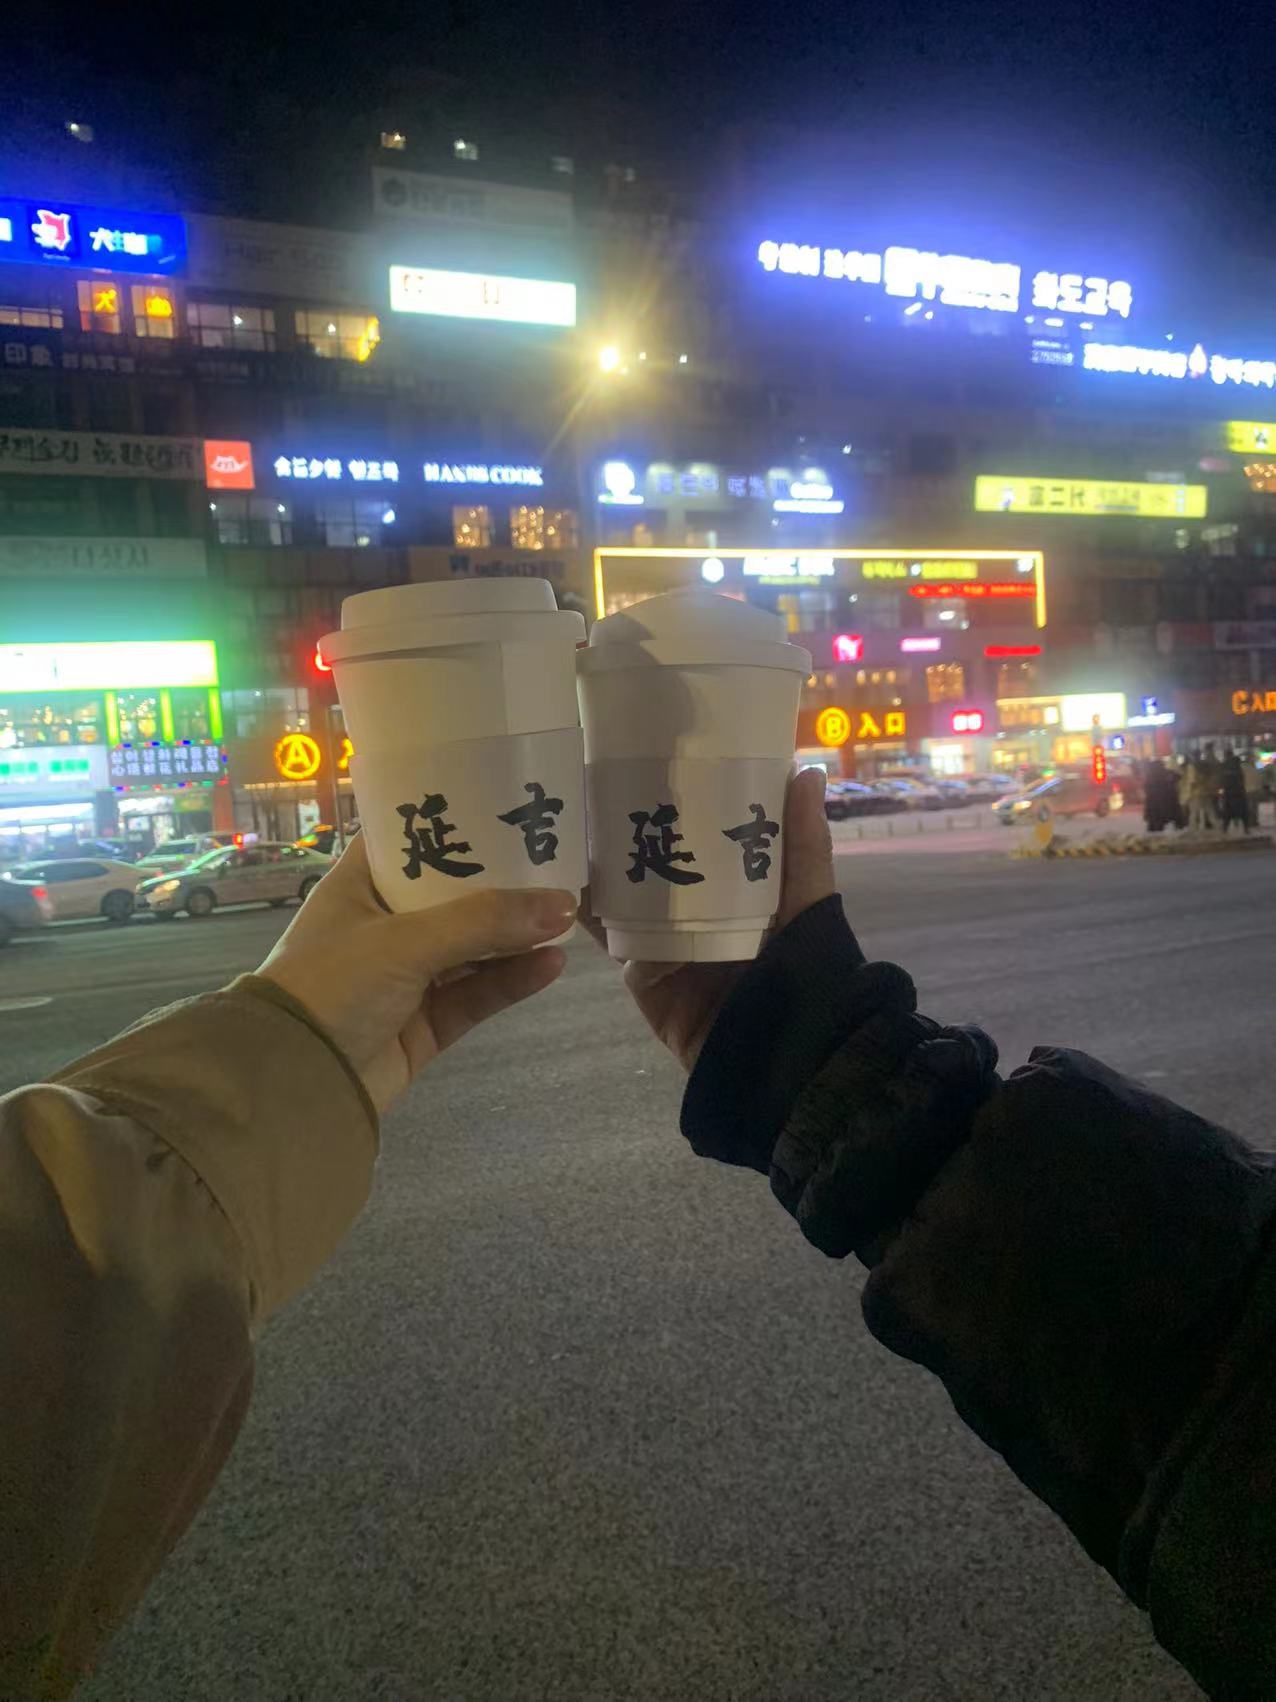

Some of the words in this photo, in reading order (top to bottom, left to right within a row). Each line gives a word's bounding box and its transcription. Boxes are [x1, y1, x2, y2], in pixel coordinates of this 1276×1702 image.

[857, 711, 905, 738] 入口
[396, 782, 564, 880] 延吉
[627, 803, 779, 885] 延吉
